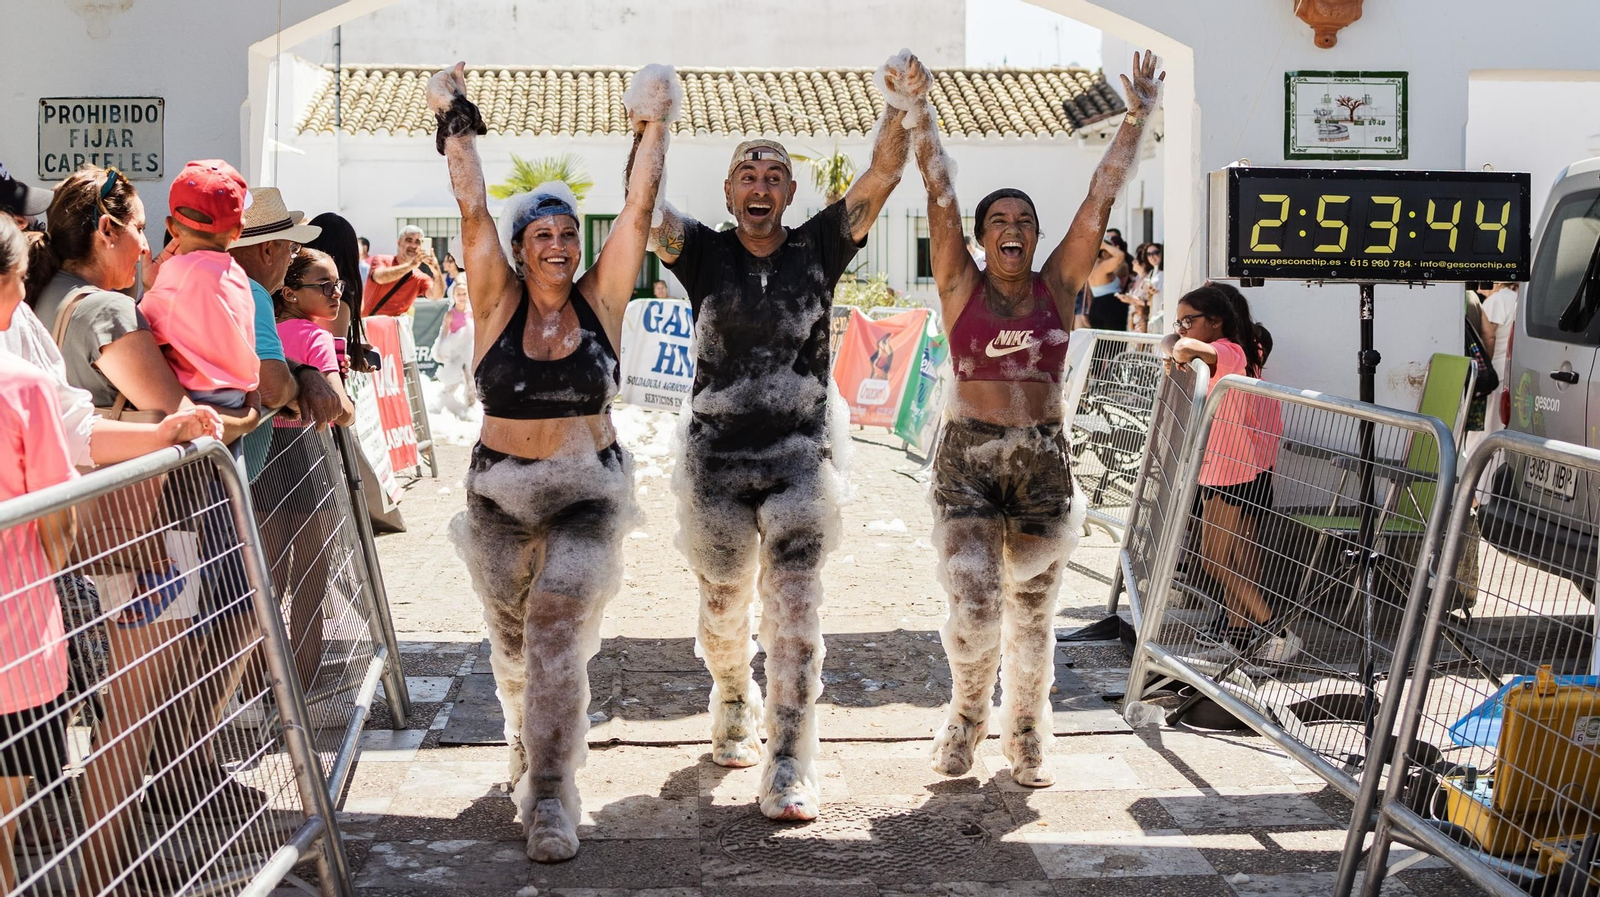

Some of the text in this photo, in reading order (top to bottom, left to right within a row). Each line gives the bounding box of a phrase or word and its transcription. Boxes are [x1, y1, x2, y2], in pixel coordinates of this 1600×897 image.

[44, 104, 158, 124] PROHIBIDO
[69, 128, 134, 148] FIJAR
[44, 153, 158, 173] CARTELES
[1250, 194, 1511, 254] 2:53:44
[1242, 258, 1341, 267] www.gesconchip.es
[1350, 259, 1369, 267] 615
[1393, 260, 1411, 268] 784
[1420, 260, 1517, 269] info@gesconchip.es
[994, 329, 1034, 346] NIKE
[644, 393, 674, 407] SERVICIOS
[1534, 395, 1560, 412] gescon
[1577, 734, 1584, 742] 6
